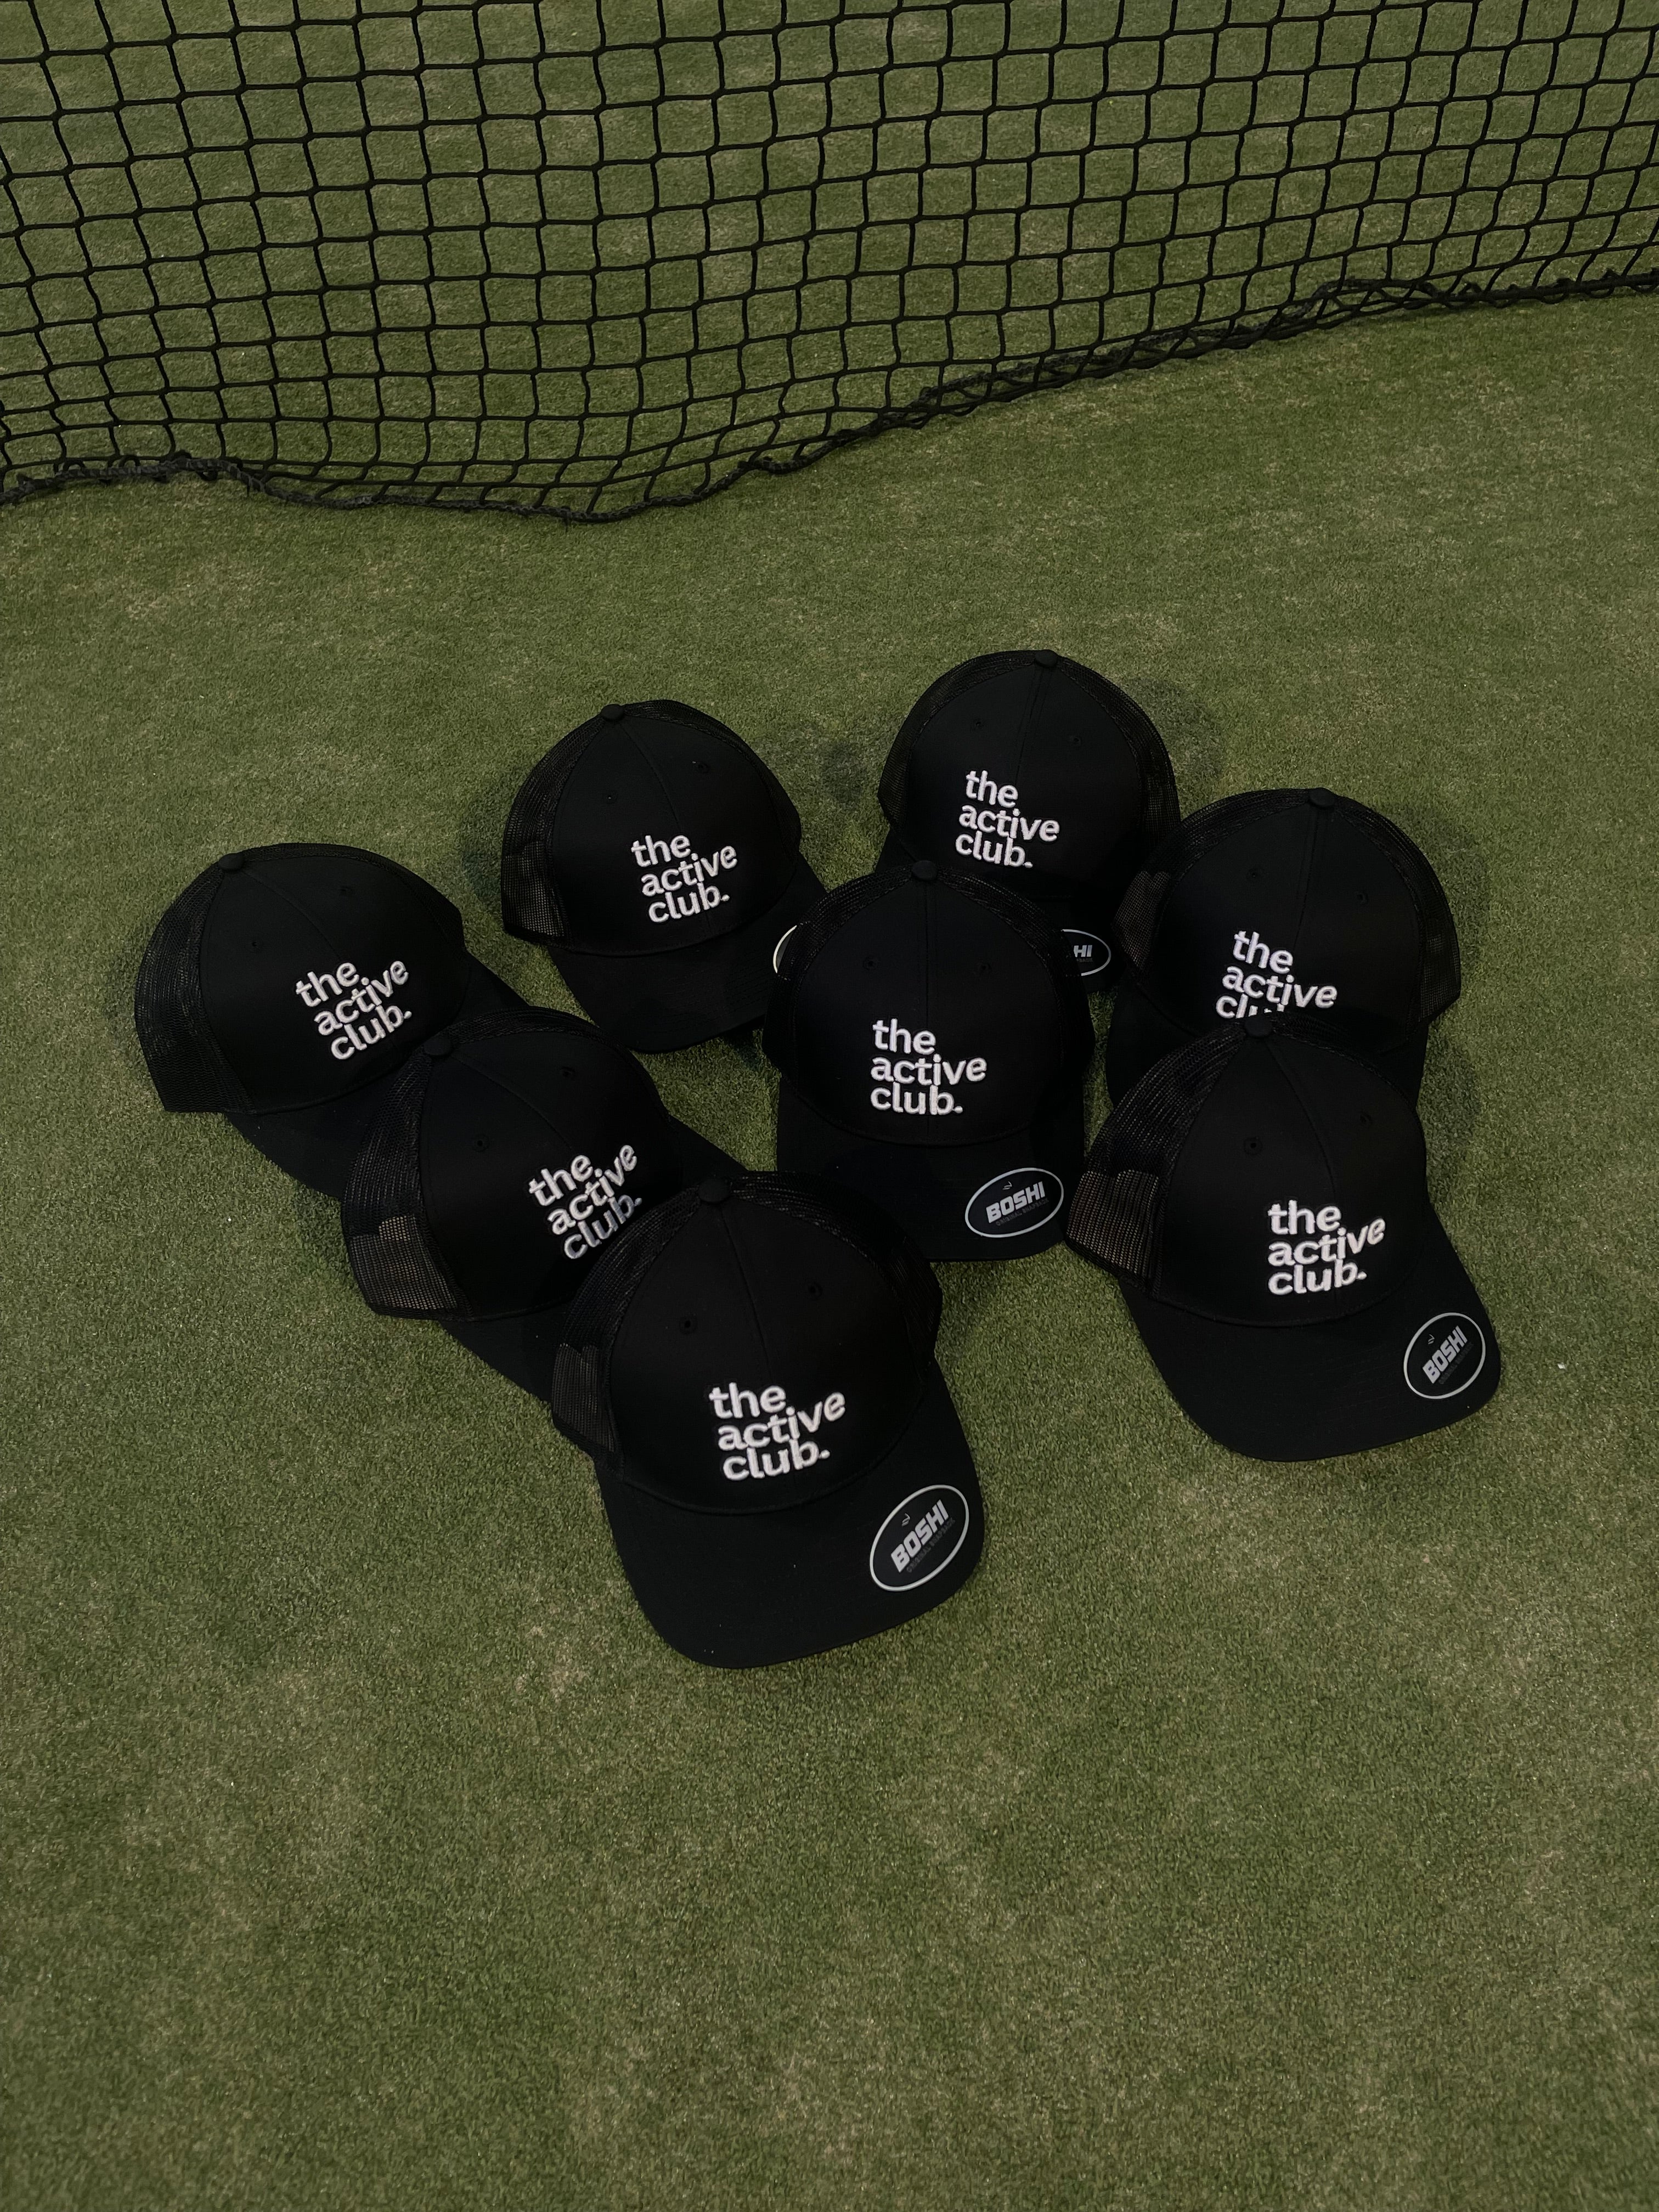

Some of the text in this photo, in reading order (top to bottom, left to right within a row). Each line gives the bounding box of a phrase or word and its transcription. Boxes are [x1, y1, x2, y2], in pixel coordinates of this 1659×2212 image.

[965, 770, 1019, 808] the
[959, 804, 1060, 843] active
[630, 834, 691, 867] the
[955, 830, 1034, 868] club.
[641, 845, 738, 897] active
[648, 881, 730, 923] club.
[1232, 930, 1294, 974] the
[296, 962, 360, 1007] the
[314, 960, 409, 1036] active
[1222, 966, 1338, 1009] active
[331, 1005, 413, 1060] club.
[872, 1018, 936, 1056] the
[870, 1053, 988, 1086] active
[870, 1081, 963, 1116] club.
[528, 1154, 594, 1206] the
[548, 1144, 637, 1235] active
[985, 1181, 1046, 1224] BOSHI
[1267, 1199, 1341, 1235] the
[564, 1194, 642, 1260] club.
[1267, 1218, 1386, 1267] active
[1267, 1259, 1368, 1295] club.
[1421, 1325, 1468, 1384] BOSHI
[709, 1382, 787, 1419] the
[718, 1393, 846, 1451] active
[723, 1437, 831, 1481] club.
[890, 1499, 949, 1573] BOSHI
